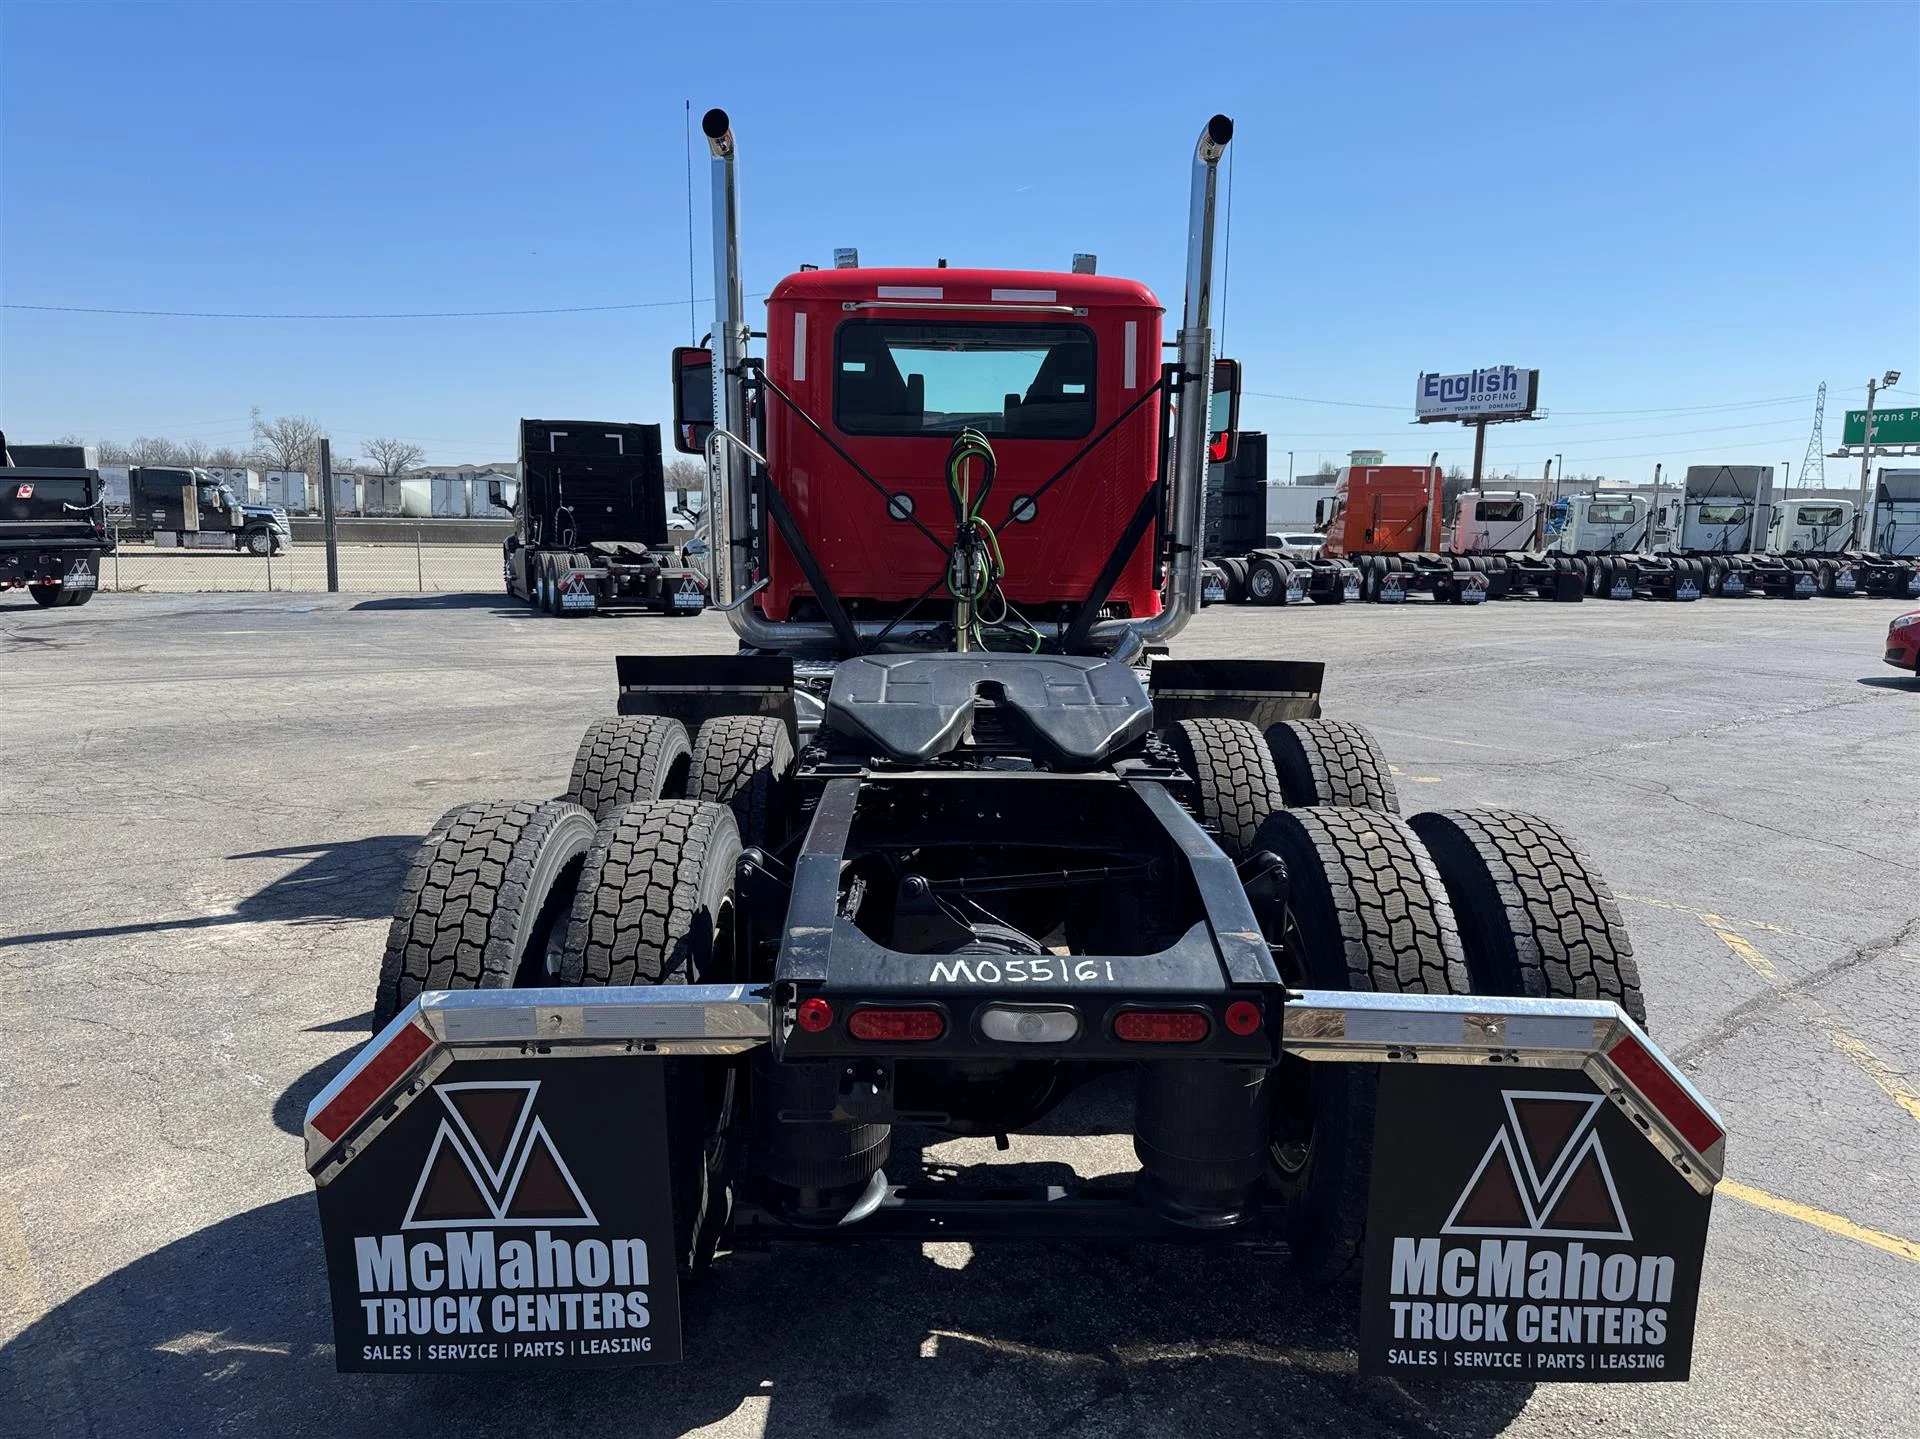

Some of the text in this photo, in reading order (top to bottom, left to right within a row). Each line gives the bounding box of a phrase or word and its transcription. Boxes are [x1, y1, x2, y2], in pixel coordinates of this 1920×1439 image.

[1424, 365, 1517, 402] English
[1470, 392, 1516, 402] ROOFING
[1852, 411, 1920, 423] Veerans P
[354, 1231, 649, 1293] McMahon
[1390, 1237, 1675, 1303] McMahon
[361, 1292, 650, 1335] TRUCK CENTERS
[1390, 1302, 1667, 1345] TRUCK CENTERS
[363, 1337, 652, 1360] SALES SERVICE PARTS LEASING
[1388, 1349, 1665, 1369] SALES SERVICE PARTS LEASING
